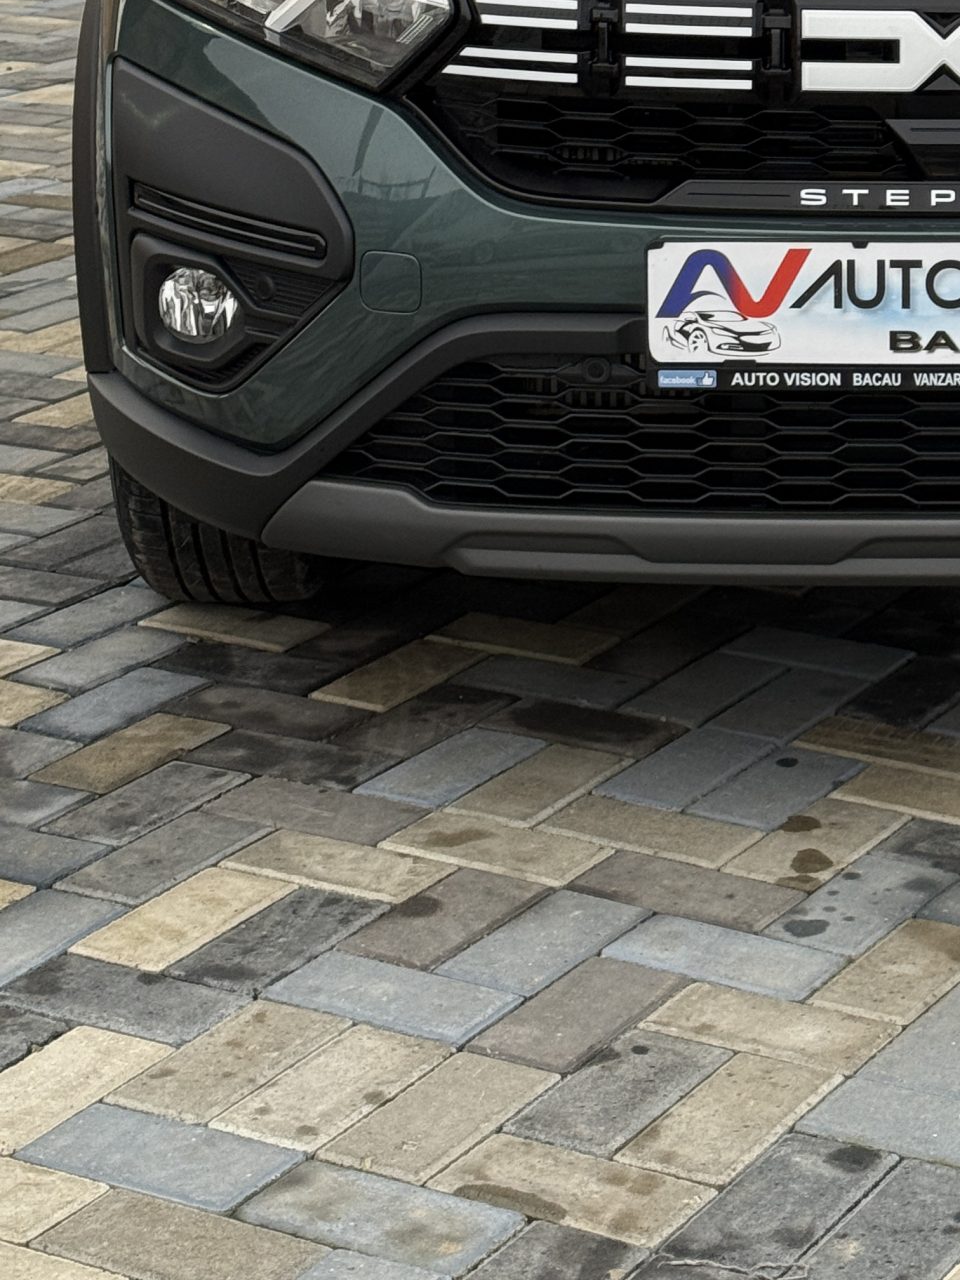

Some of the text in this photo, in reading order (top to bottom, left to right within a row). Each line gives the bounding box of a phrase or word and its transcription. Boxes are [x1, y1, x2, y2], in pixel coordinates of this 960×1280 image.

[659, 374, 696, 385] facebook
[731, 373, 780, 386] AUTO
[784, 372, 841, 386] VISION
[852, 373, 901, 386] BACAU
